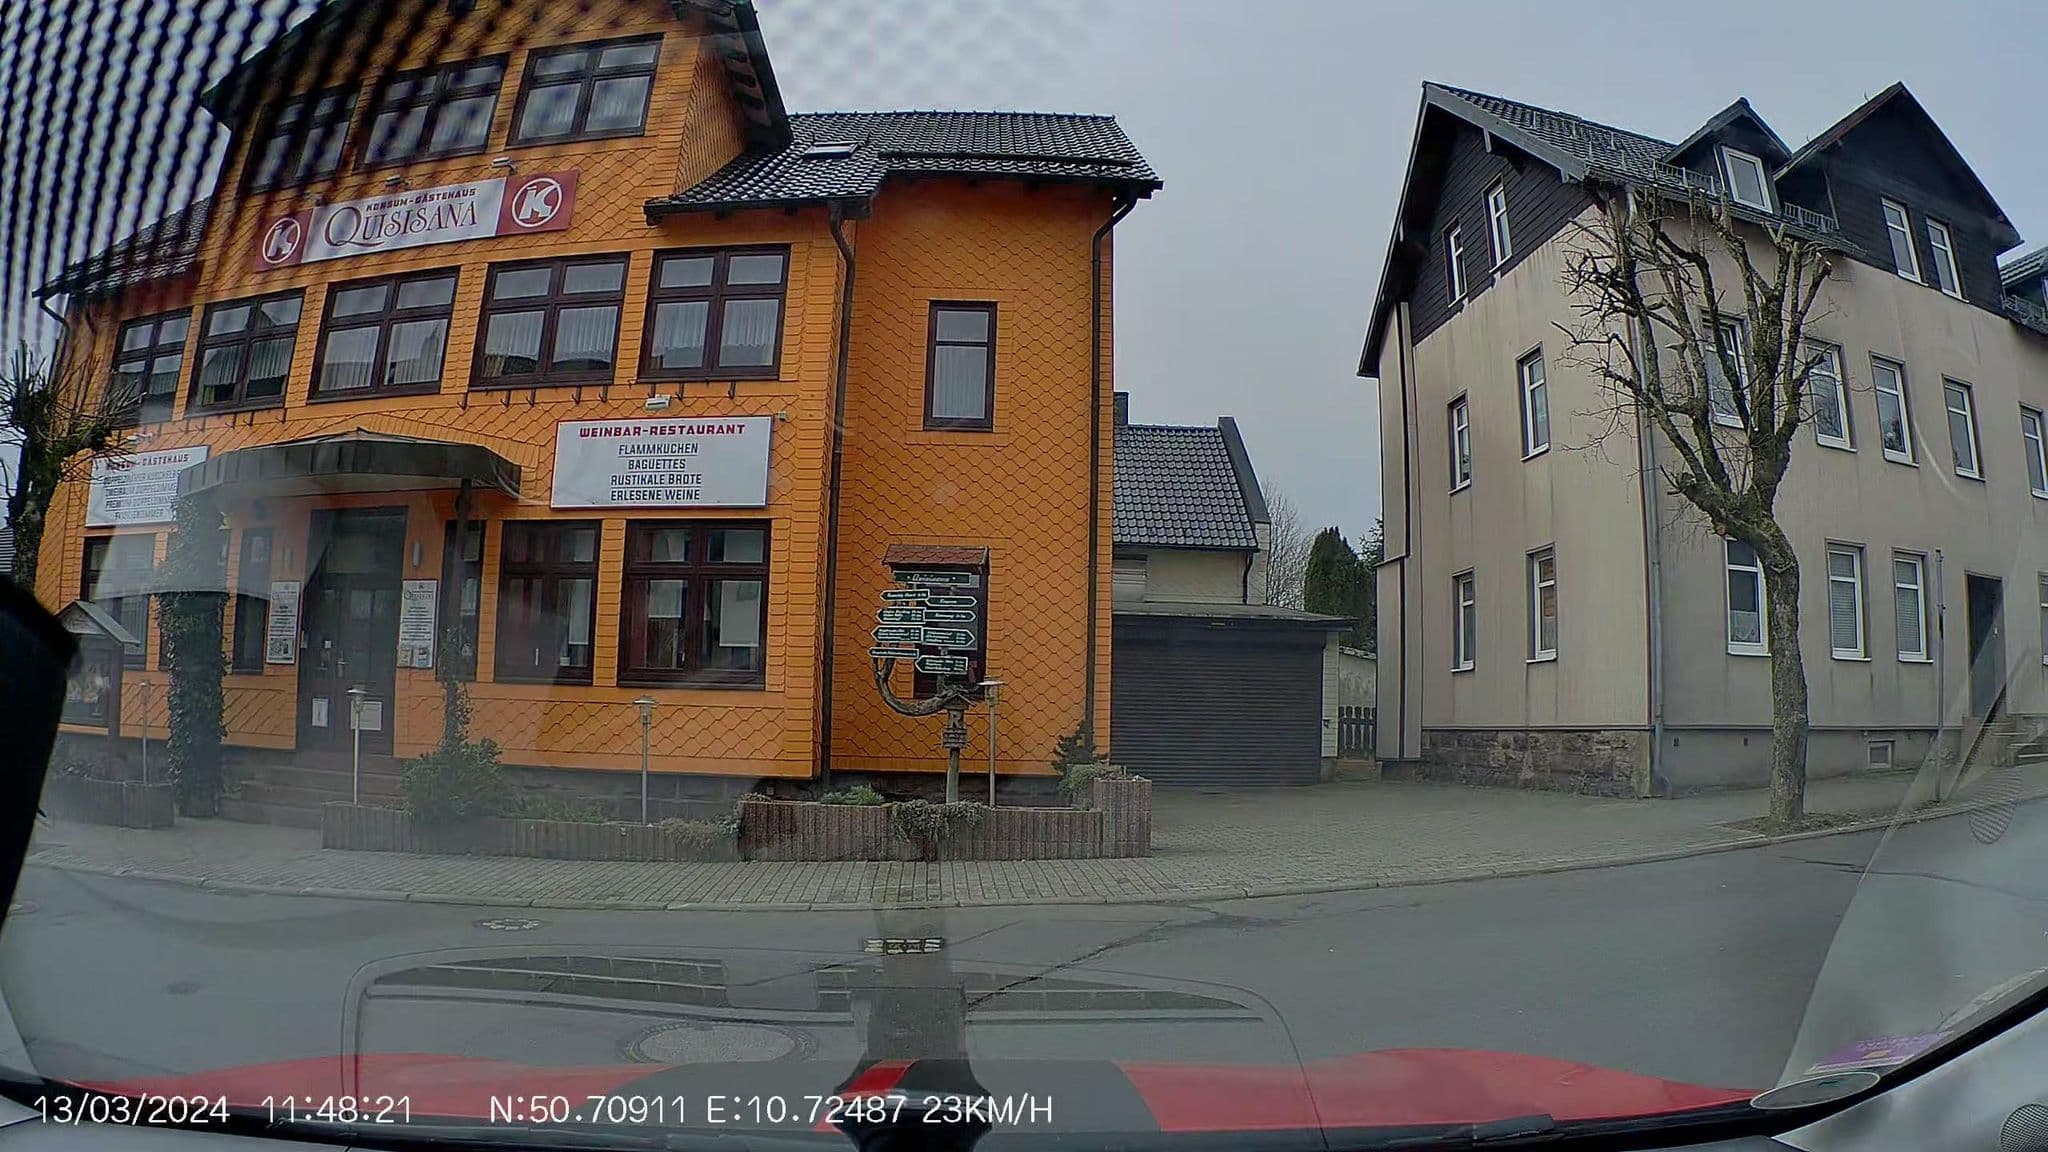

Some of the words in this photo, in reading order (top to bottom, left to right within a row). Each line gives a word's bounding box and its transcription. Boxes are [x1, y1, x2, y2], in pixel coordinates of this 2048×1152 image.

[365, 187, 476, 212] KONSUM-GÄSTEHAUS
[579, 424, 746, 438] WEINBAR-RESTAURANT
[618, 443, 698, 455] FLAMMKUCHEN
[628, 458, 686, 470] BAGUETTES
[610, 474, 666, 486] RUSTIKALE
[668, 473, 702, 485] BROTE
[610, 489, 662, 501] ERLESENE
[665, 488, 701, 500] WEINE
